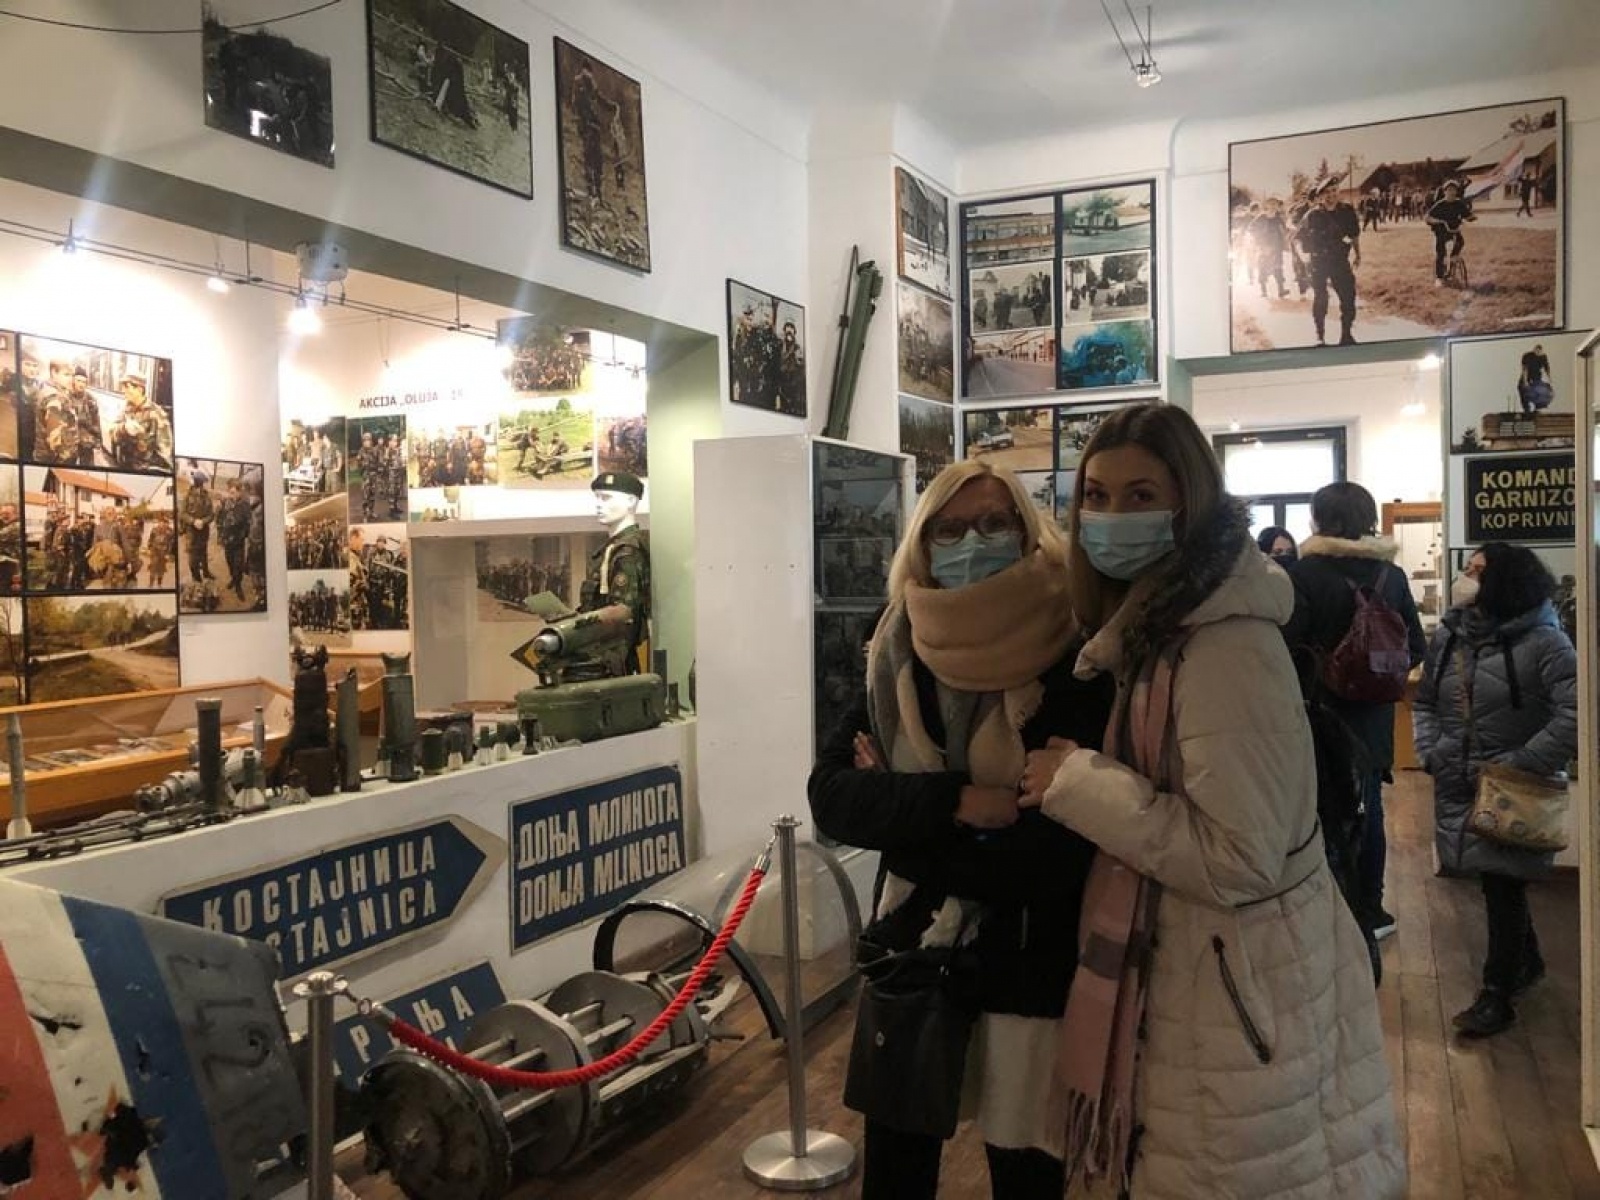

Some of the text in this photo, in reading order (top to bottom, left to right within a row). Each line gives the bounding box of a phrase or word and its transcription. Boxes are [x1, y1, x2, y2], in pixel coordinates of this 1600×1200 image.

[359, 395, 397, 409] AKCIJA
[1475, 488, 1575, 509] GARNIZO
[518, 810, 581, 870] ДОЊА
[202, 835, 437, 934] КОСТАЈНИЦА
[519, 831, 681, 926] DONJA MLINOGA
